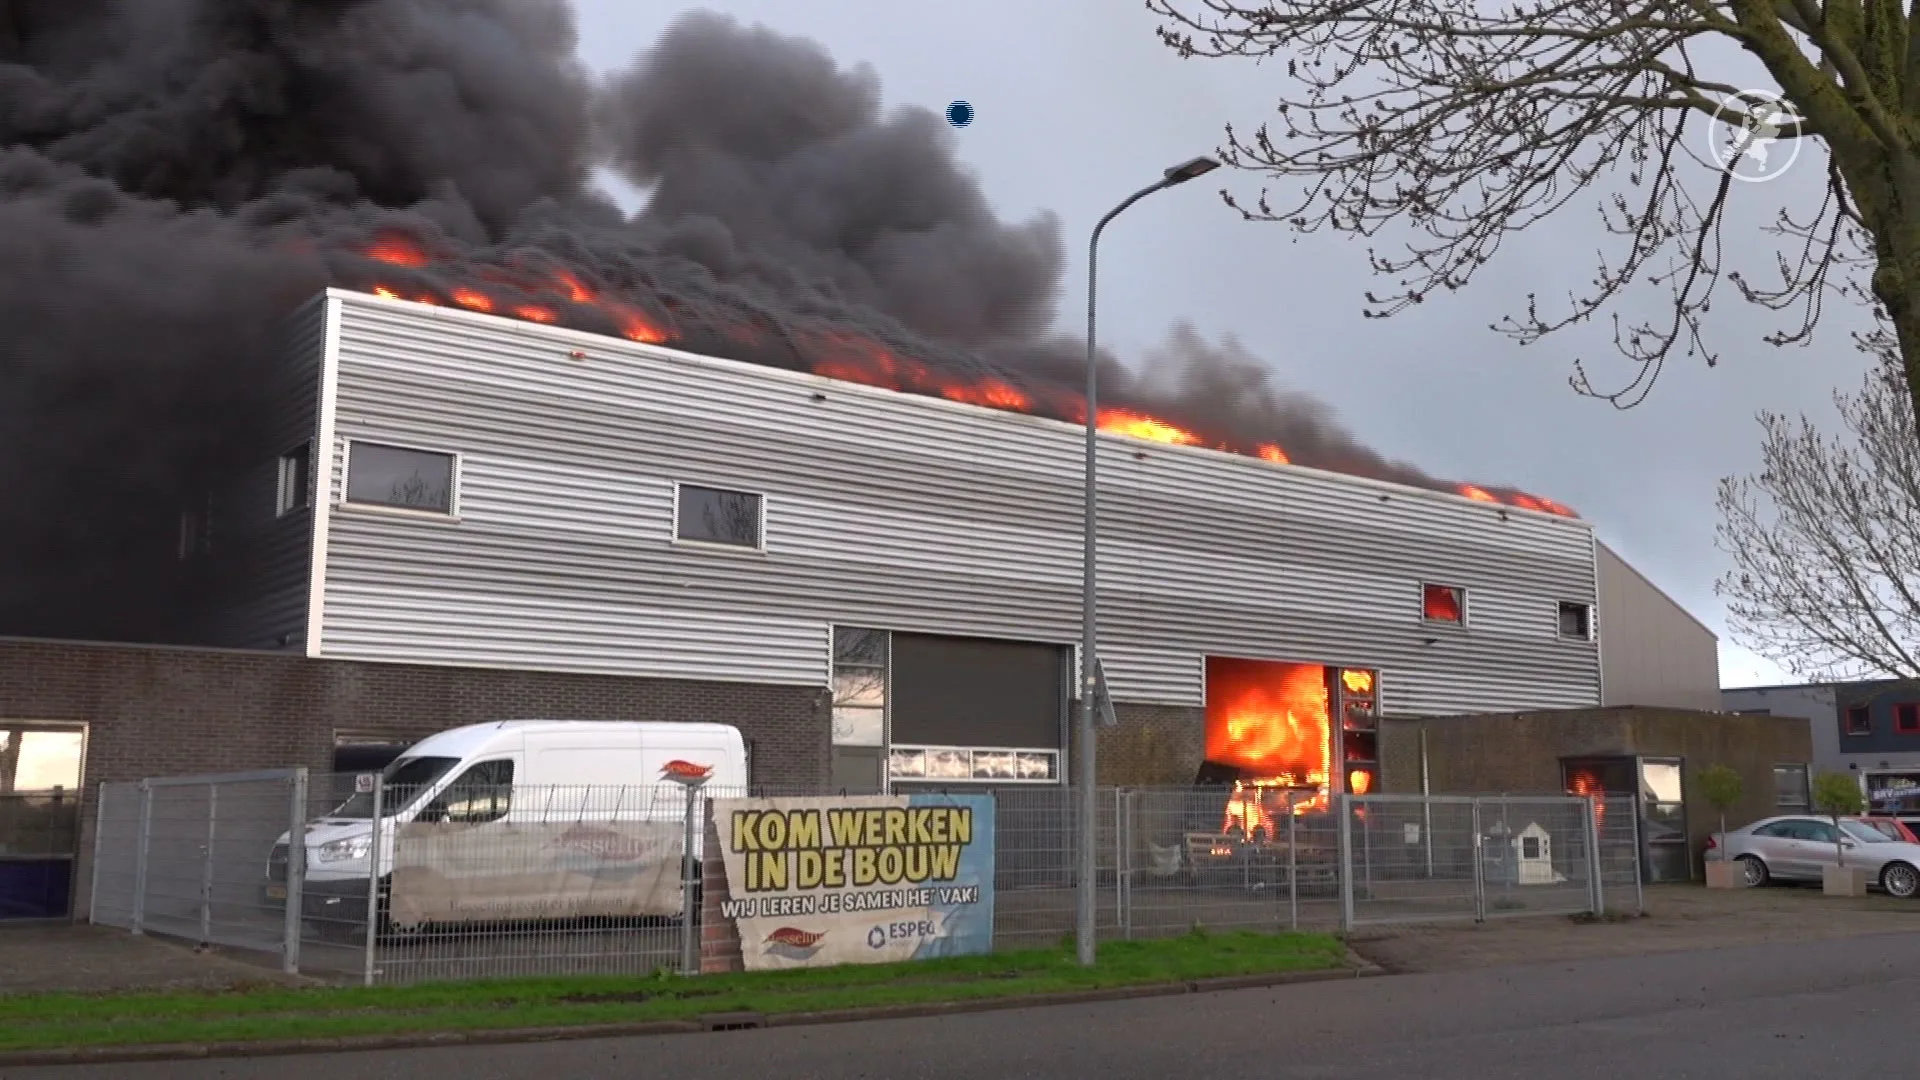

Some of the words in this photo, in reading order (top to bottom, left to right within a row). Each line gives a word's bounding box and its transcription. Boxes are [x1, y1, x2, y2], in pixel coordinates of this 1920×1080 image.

[731, 808, 823, 852] KOM
[827, 806, 973, 848] WERKEN
[745, 850, 789, 893] IN
[797, 848, 847, 889] DE
[853, 844, 963, 885] BOUW
[720, 899, 757, 919] WIJ
[760, 895, 815, 917] LEREN
[818, 893, 841, 914] JE
[843, 889, 904, 912] SAMEN
[938, 885, 979, 904] VAK!
